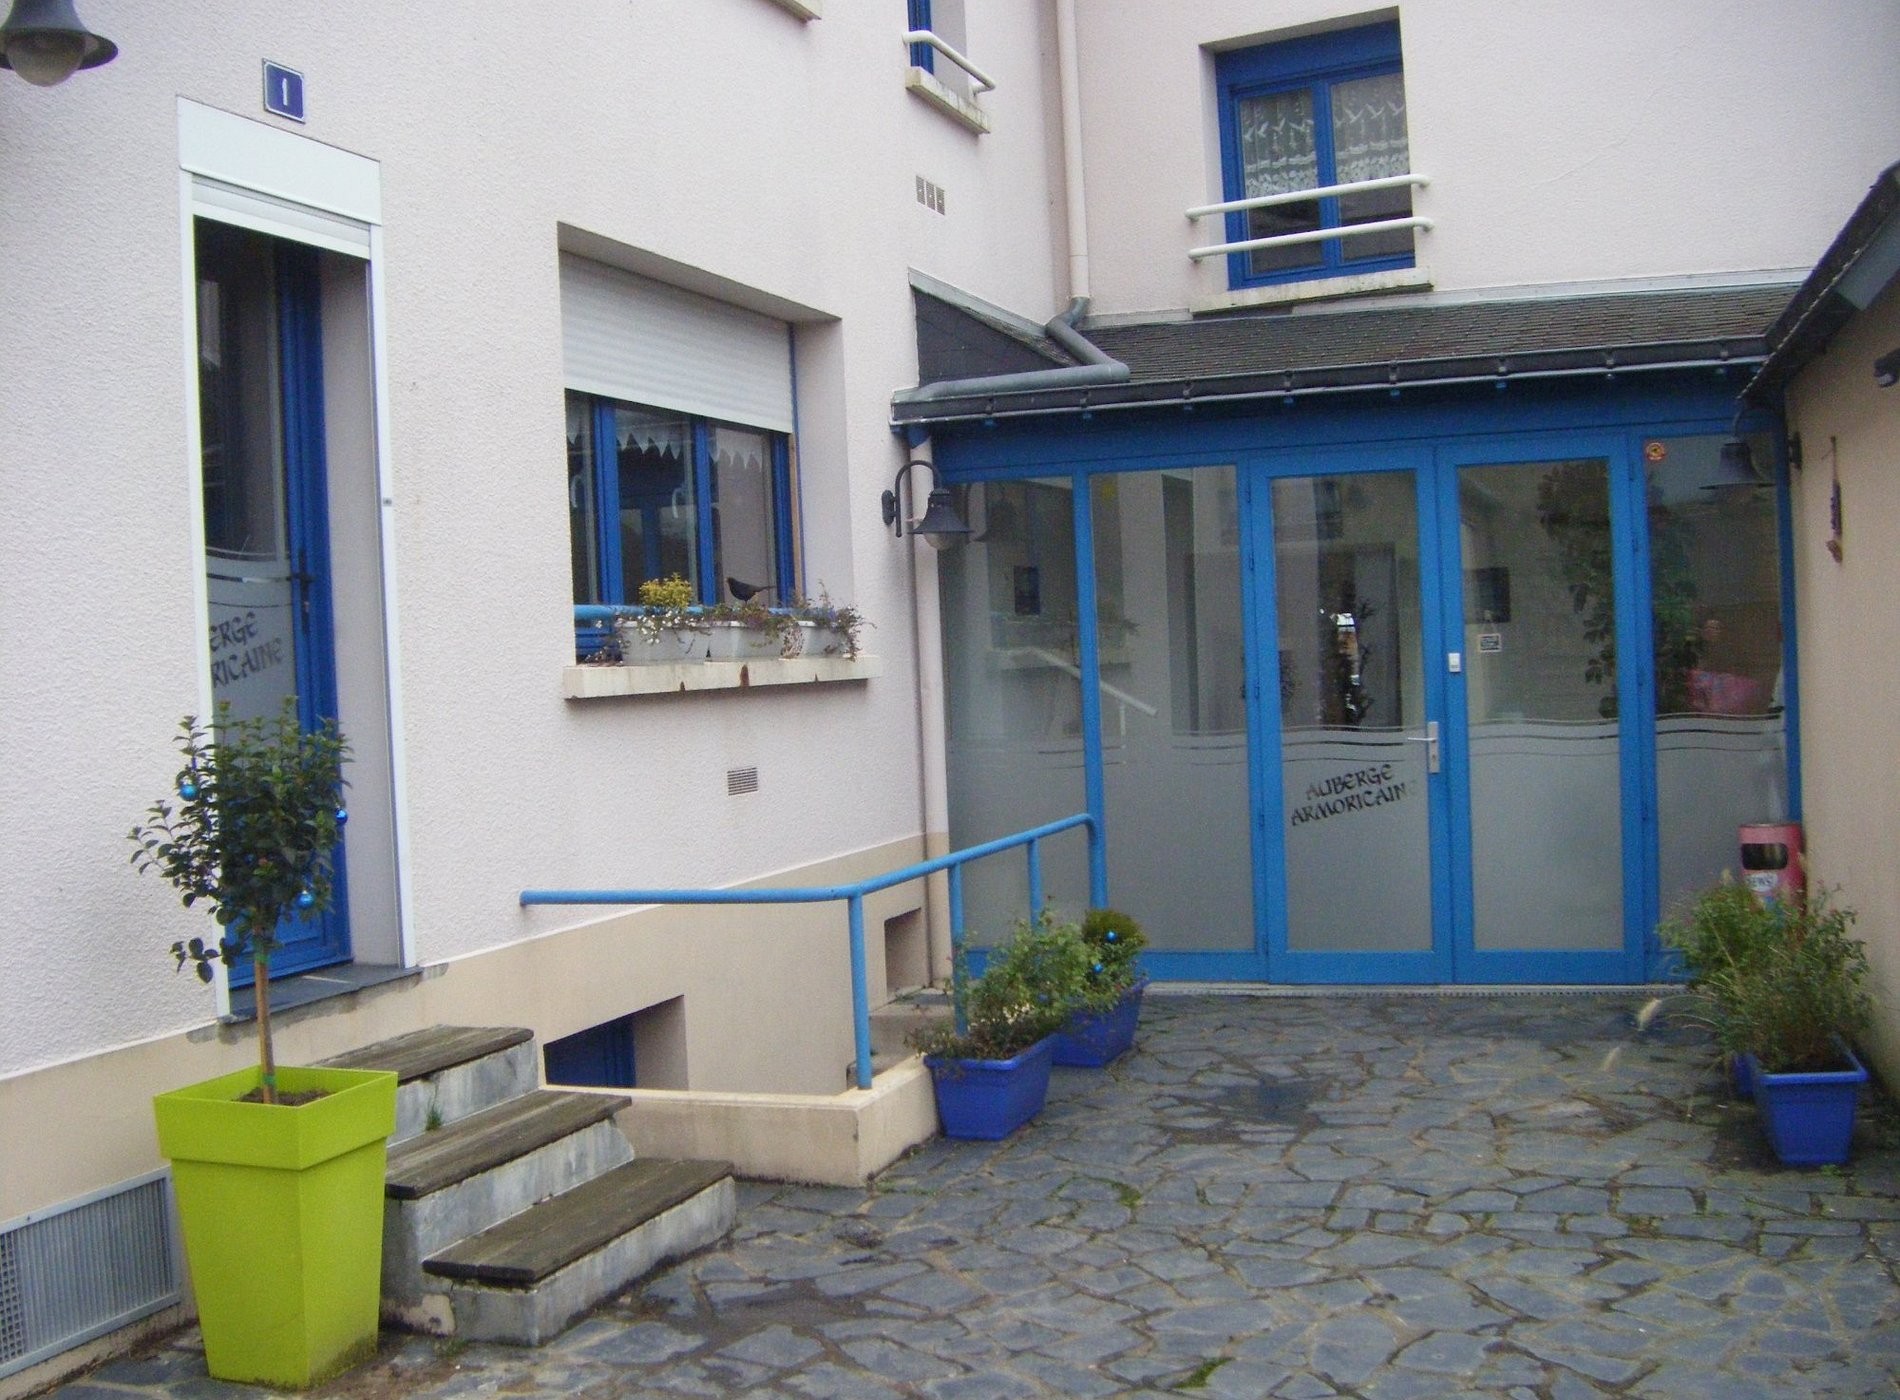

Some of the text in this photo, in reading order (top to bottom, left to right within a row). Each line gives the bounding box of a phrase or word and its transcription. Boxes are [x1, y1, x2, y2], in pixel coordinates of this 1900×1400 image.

[281, 78, 288, 106] 1
[209, 611, 258, 652] ERGE
[211, 637, 283, 688] RICAINE
[1305, 763, 1393, 801] AUBERGE
[1291, 779, 1417, 827] ARMORICAIN
